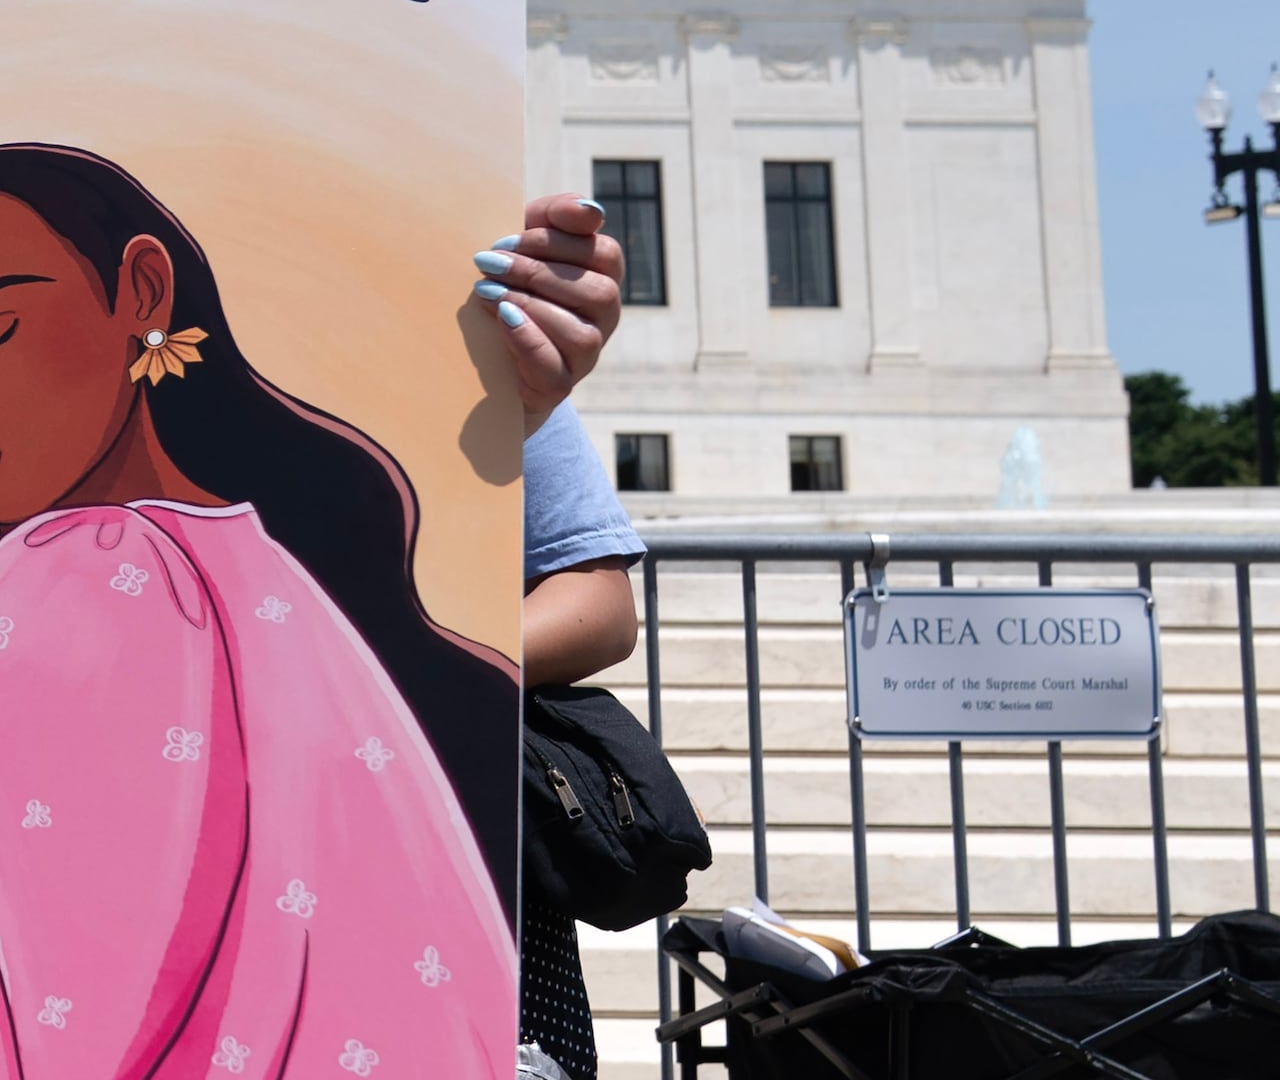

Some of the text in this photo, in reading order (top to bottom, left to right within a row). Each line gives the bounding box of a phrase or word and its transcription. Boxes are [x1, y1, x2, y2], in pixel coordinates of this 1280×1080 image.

[886, 617, 1122, 646] AREA CLOSED
[883, 677, 1129, 693] By order of the Supreme Court Marshal
[999, 701, 1031, 711] Section
